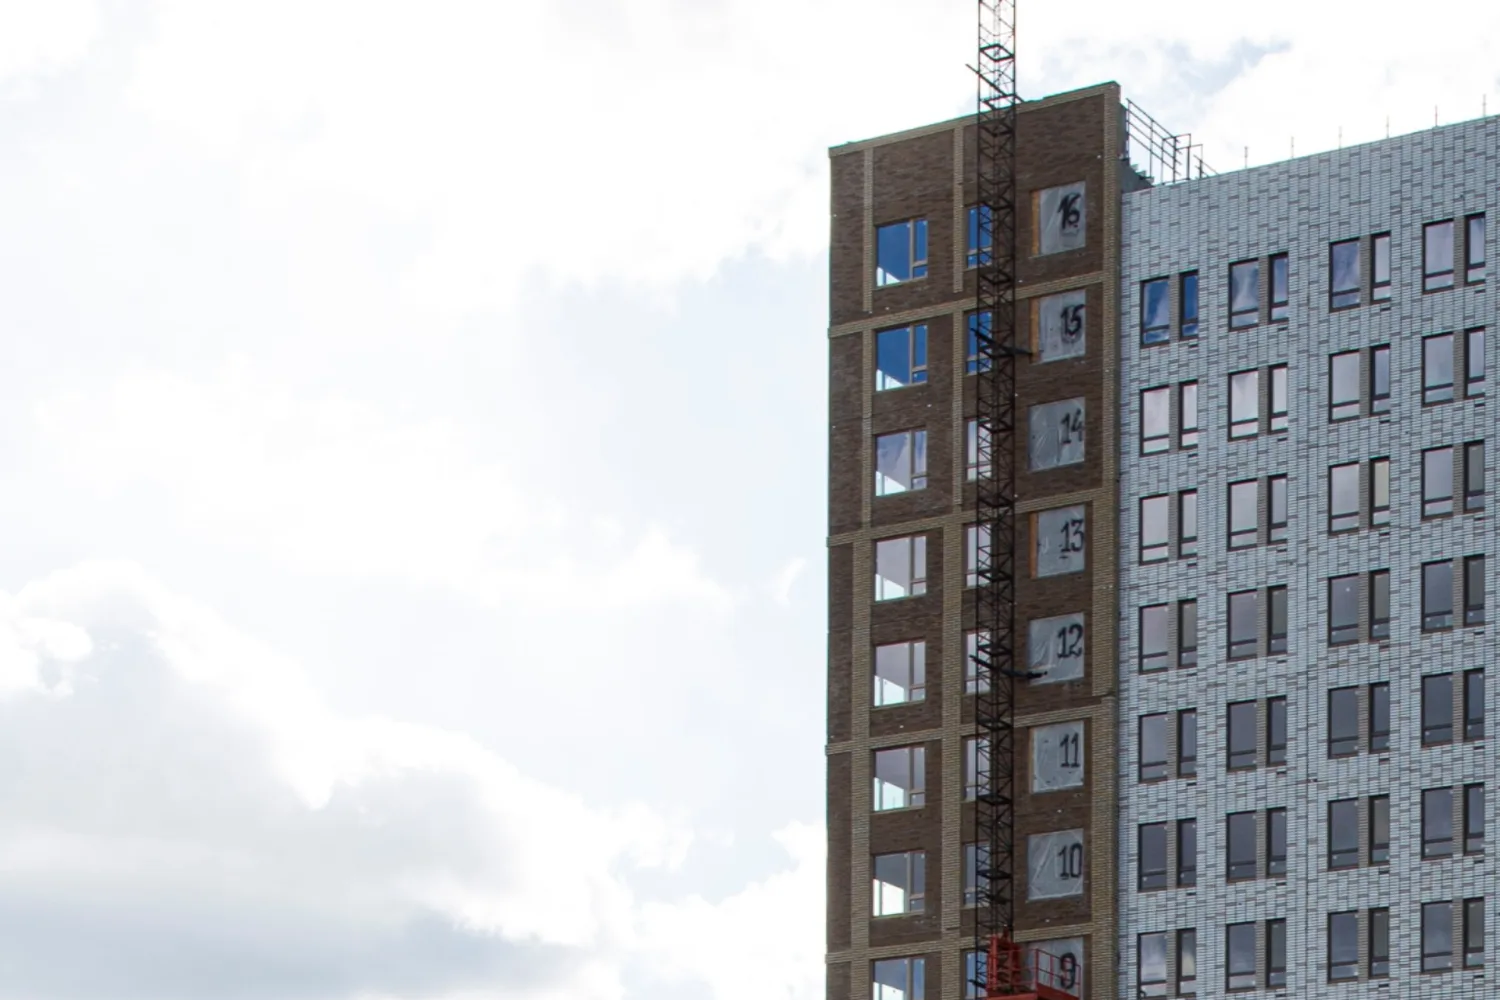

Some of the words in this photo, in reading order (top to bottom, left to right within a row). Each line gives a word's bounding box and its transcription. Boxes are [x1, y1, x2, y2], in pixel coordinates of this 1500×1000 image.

[1057, 192, 1081, 228] 16
[1060, 304, 1084, 336] 15
[1060, 409, 1083, 444] 14
[1060, 519, 1084, 557] 13
[1057, 624, 1083, 658] 12
[1060, 733, 1080, 768] 11
[1059, 843, 1083, 880] 10
[1060, 952, 1077, 989] 9
